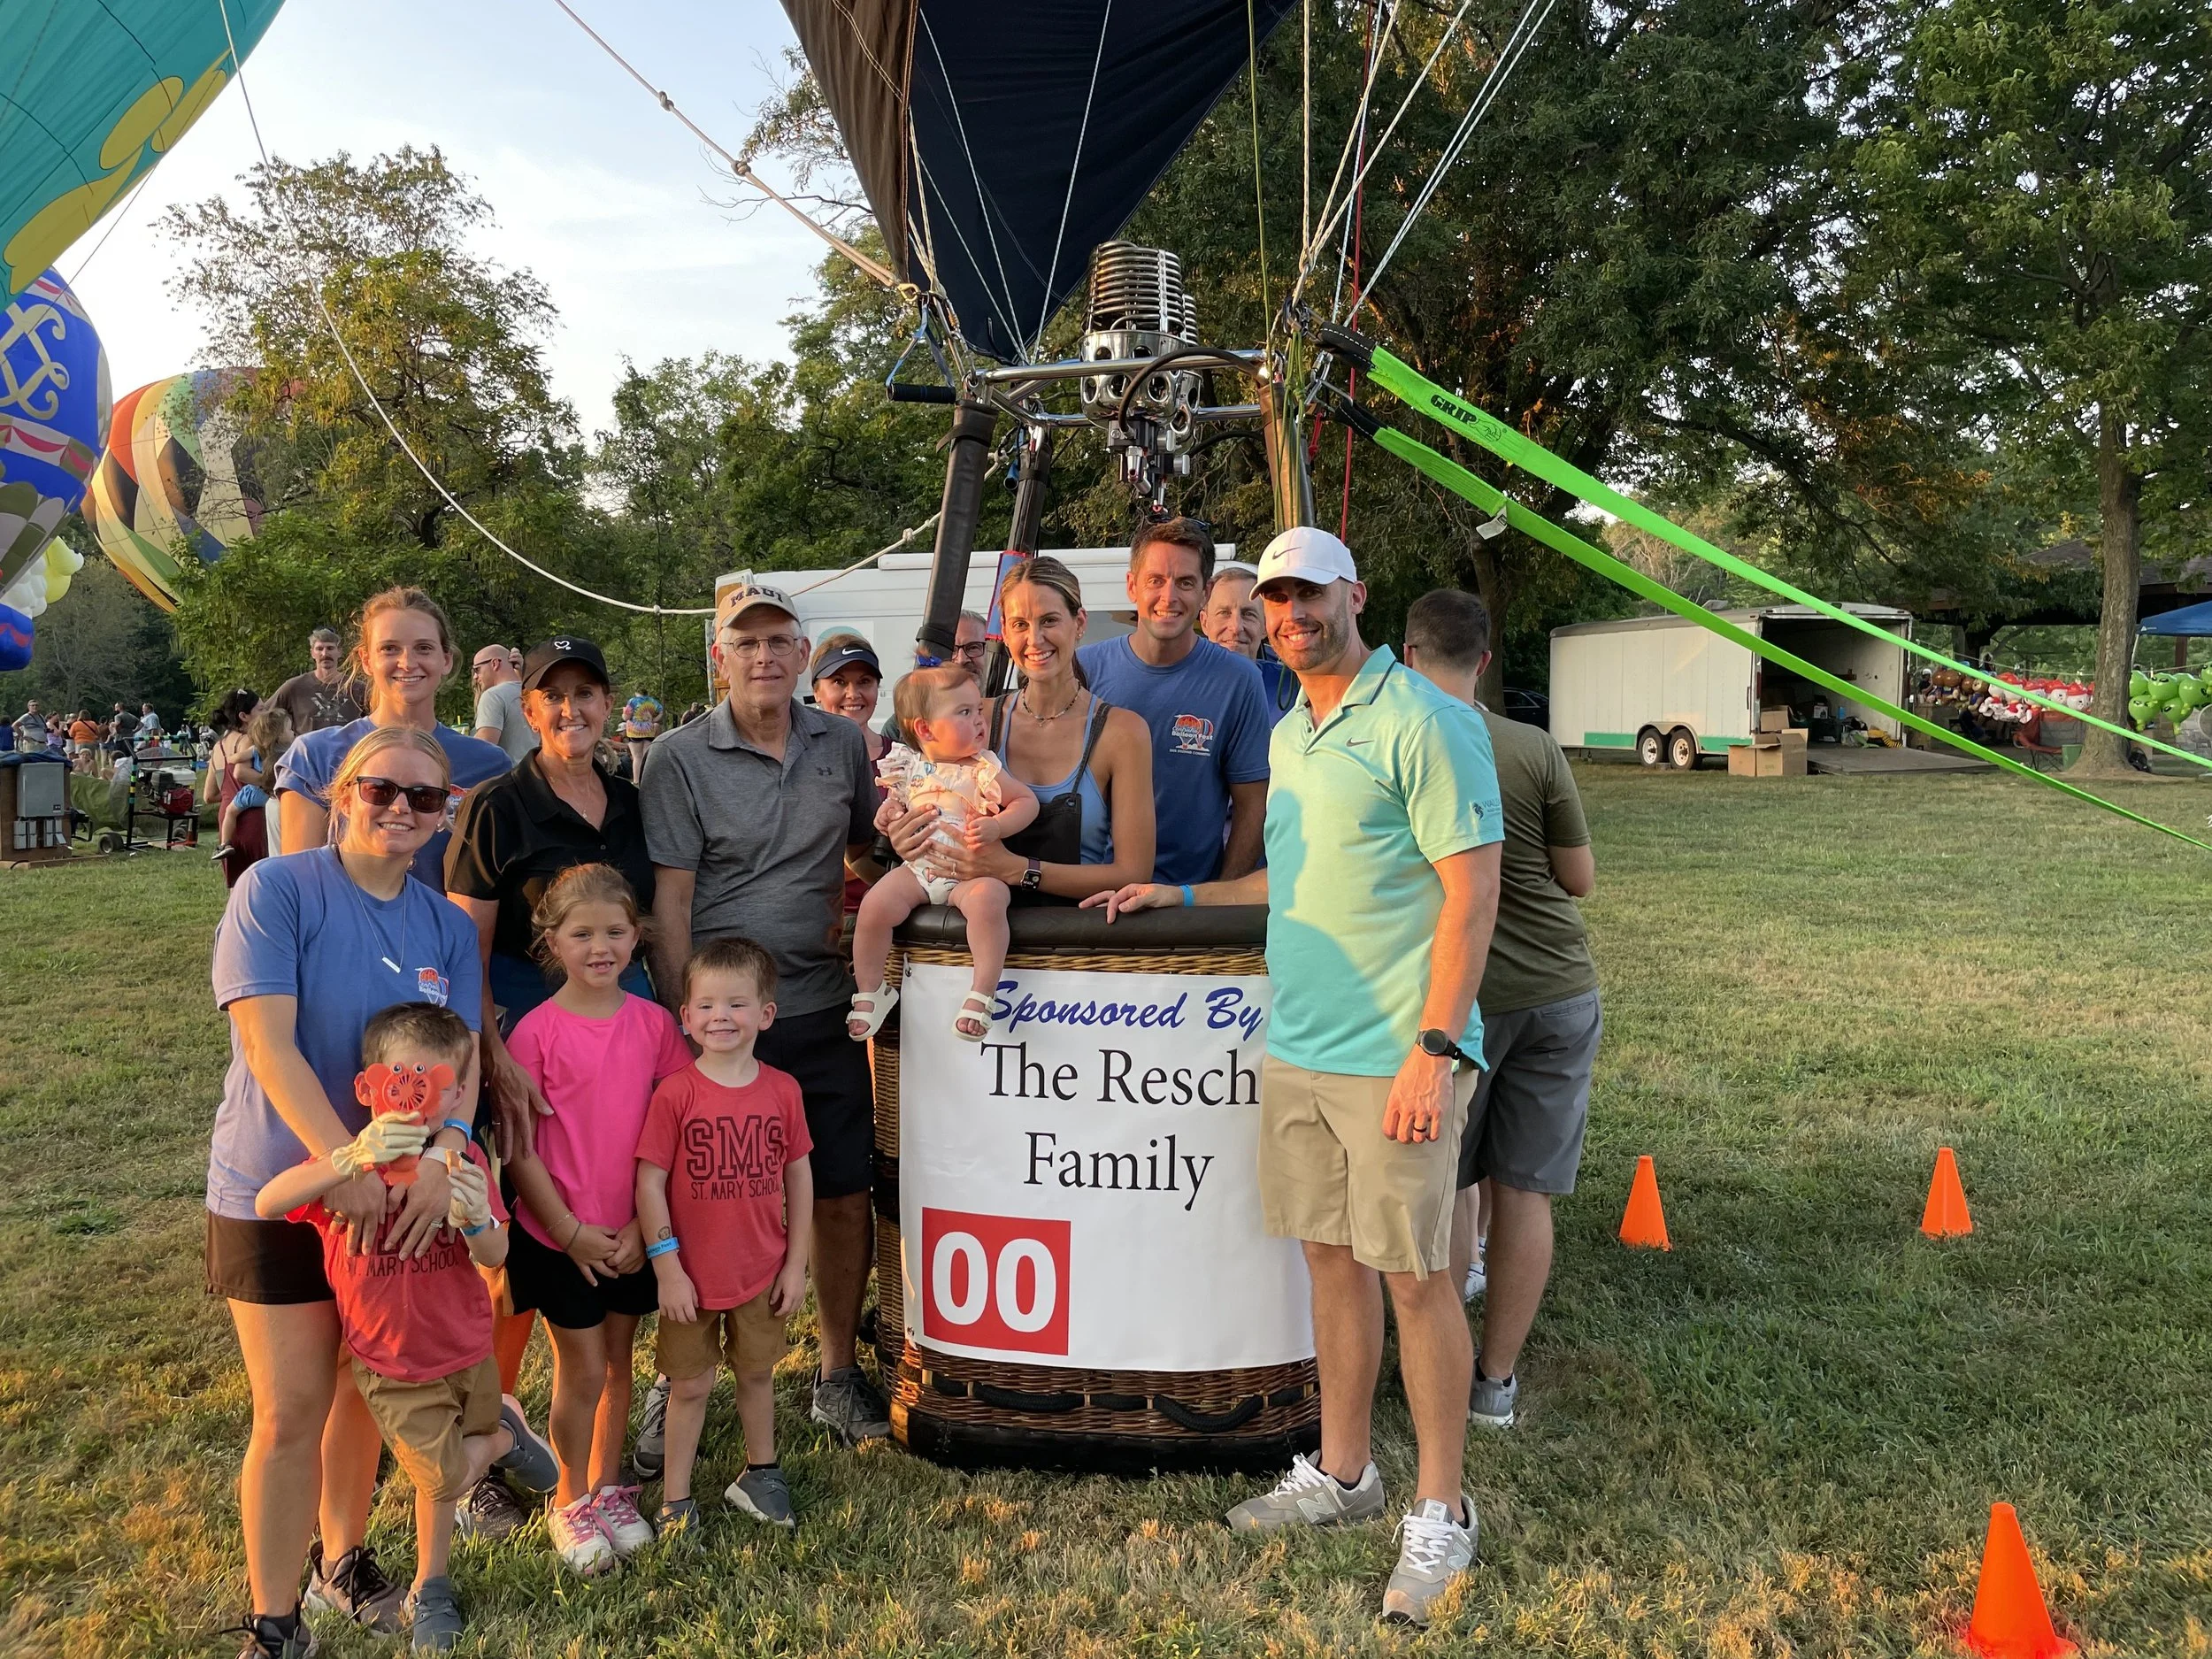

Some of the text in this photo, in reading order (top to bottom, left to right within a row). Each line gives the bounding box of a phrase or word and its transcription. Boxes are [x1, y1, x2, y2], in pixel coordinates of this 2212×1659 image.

[1431, 395, 1479, 424] GRIP
[731, 588, 783, 607] MAUI
[991, 980, 1263, 1041] Sponsored By
[980, 1041, 1260, 1106] The Resch
[684, 1115, 786, 1181] SMS
[1023, 1131, 1215, 1211] Family
[691, 1181, 708, 1200] ST.
[710, 1180, 745, 1200] MARY
[932, 1231, 1057, 1333] 00
